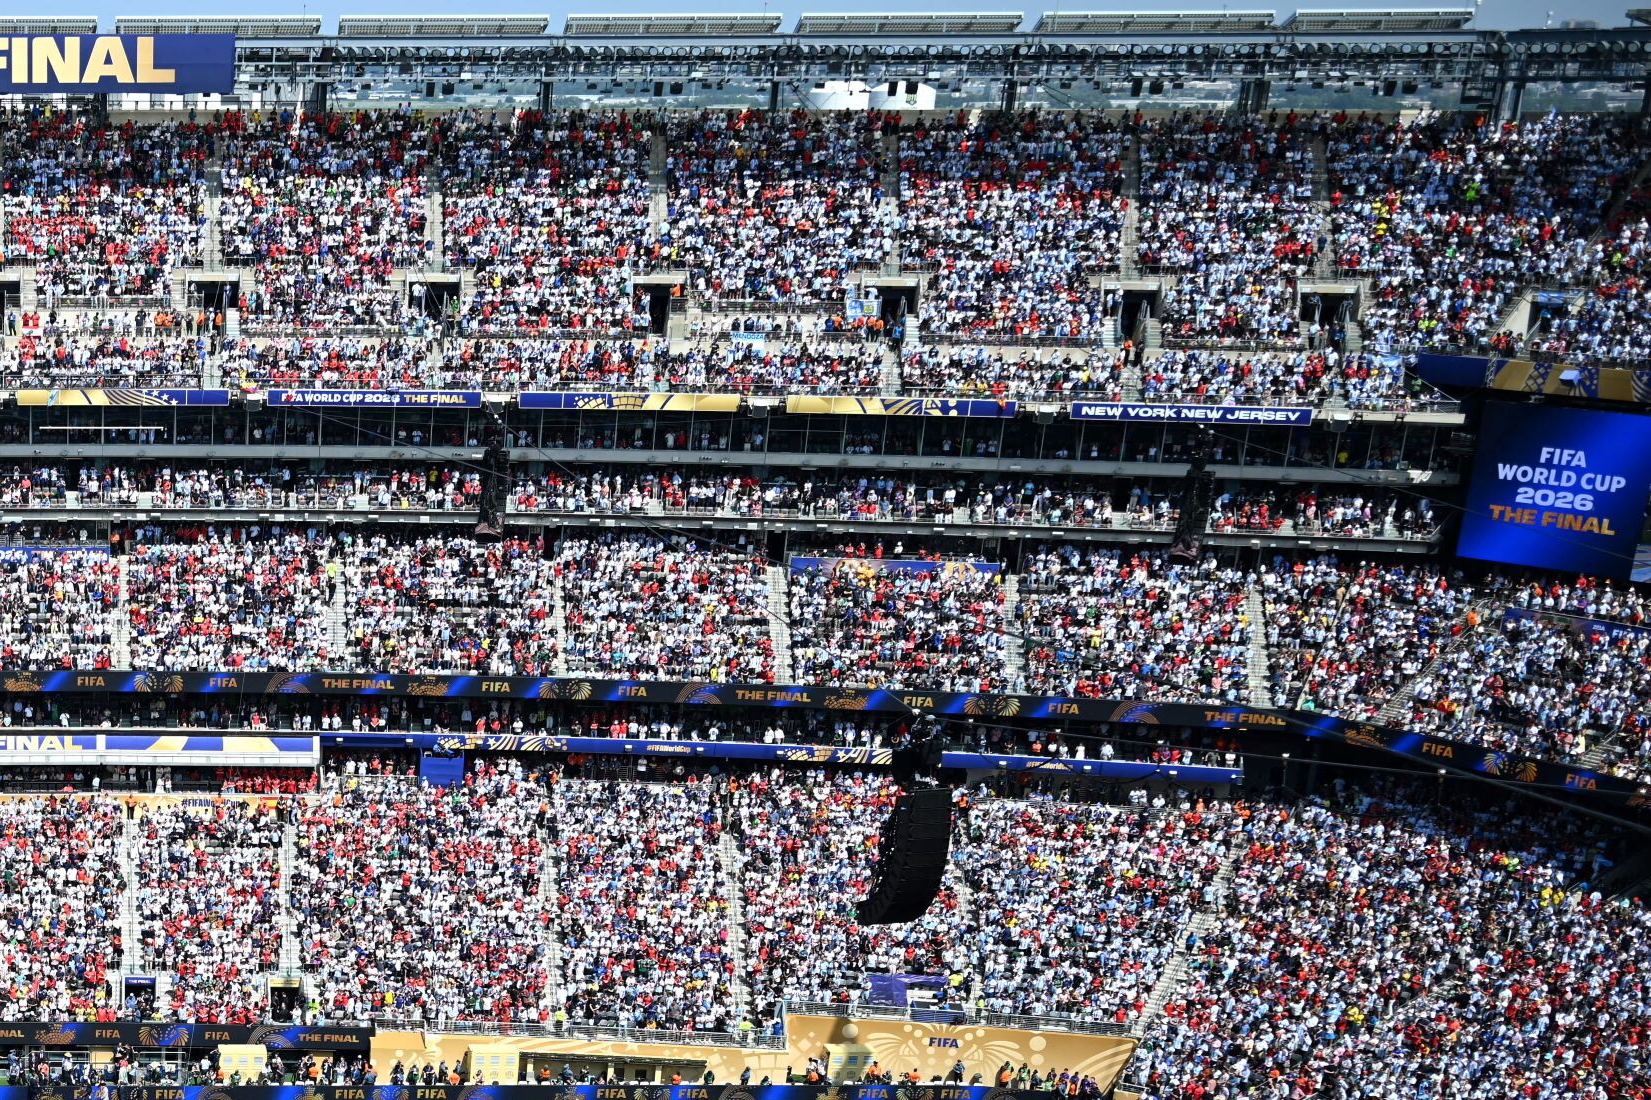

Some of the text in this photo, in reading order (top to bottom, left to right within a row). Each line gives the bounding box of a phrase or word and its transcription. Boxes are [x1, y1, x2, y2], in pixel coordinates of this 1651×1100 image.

[281, 393, 466, 404] FFA WORLD CUP 2026 THE FINAL
[1082, 406, 1300, 421] NEW YORK NEW JERSEY
[1539, 447, 1586, 467] FIFA
[1497, 463, 1626, 493] WORLD CUP
[1515, 488, 1594, 511] 2026
[1489, 504, 1615, 535] THE FINAL
[77, 676, 105, 687] FIFA
[209, 677, 237, 688] FIFA
[322, 679, 394, 690] THE FINAL
[481, 682, 510, 693] FIFA
[618, 686, 647, 697] FIFA
[735, 690, 811, 703] THE FINAL
[903, 696, 934, 708] FIFA
[1048, 703, 1079, 715] FIFA
[1204, 711, 1286, 725] THE FINAL
[1422, 743, 1453, 758] FIFA
[1566, 773, 1596, 790] FIFA
[96, 1029, 120, 1038] FIFA
[205, 1032, 230, 1040] FIFA
[298, 1033, 359, 1042] THE FINAL
[929, 1037, 959, 1048] FIFA
[155, 1090, 184, 1099] FIFA
[335, 1089, 364, 1099] FIFA
[417, 1089, 446, 1099] FIFA
[597, 1089, 626, 1099] FIFA
[678, 1089, 708, 1099] FIFA
[858, 1089, 888, 1099] FIFA
[941, 1089, 972, 1099] FIFA
